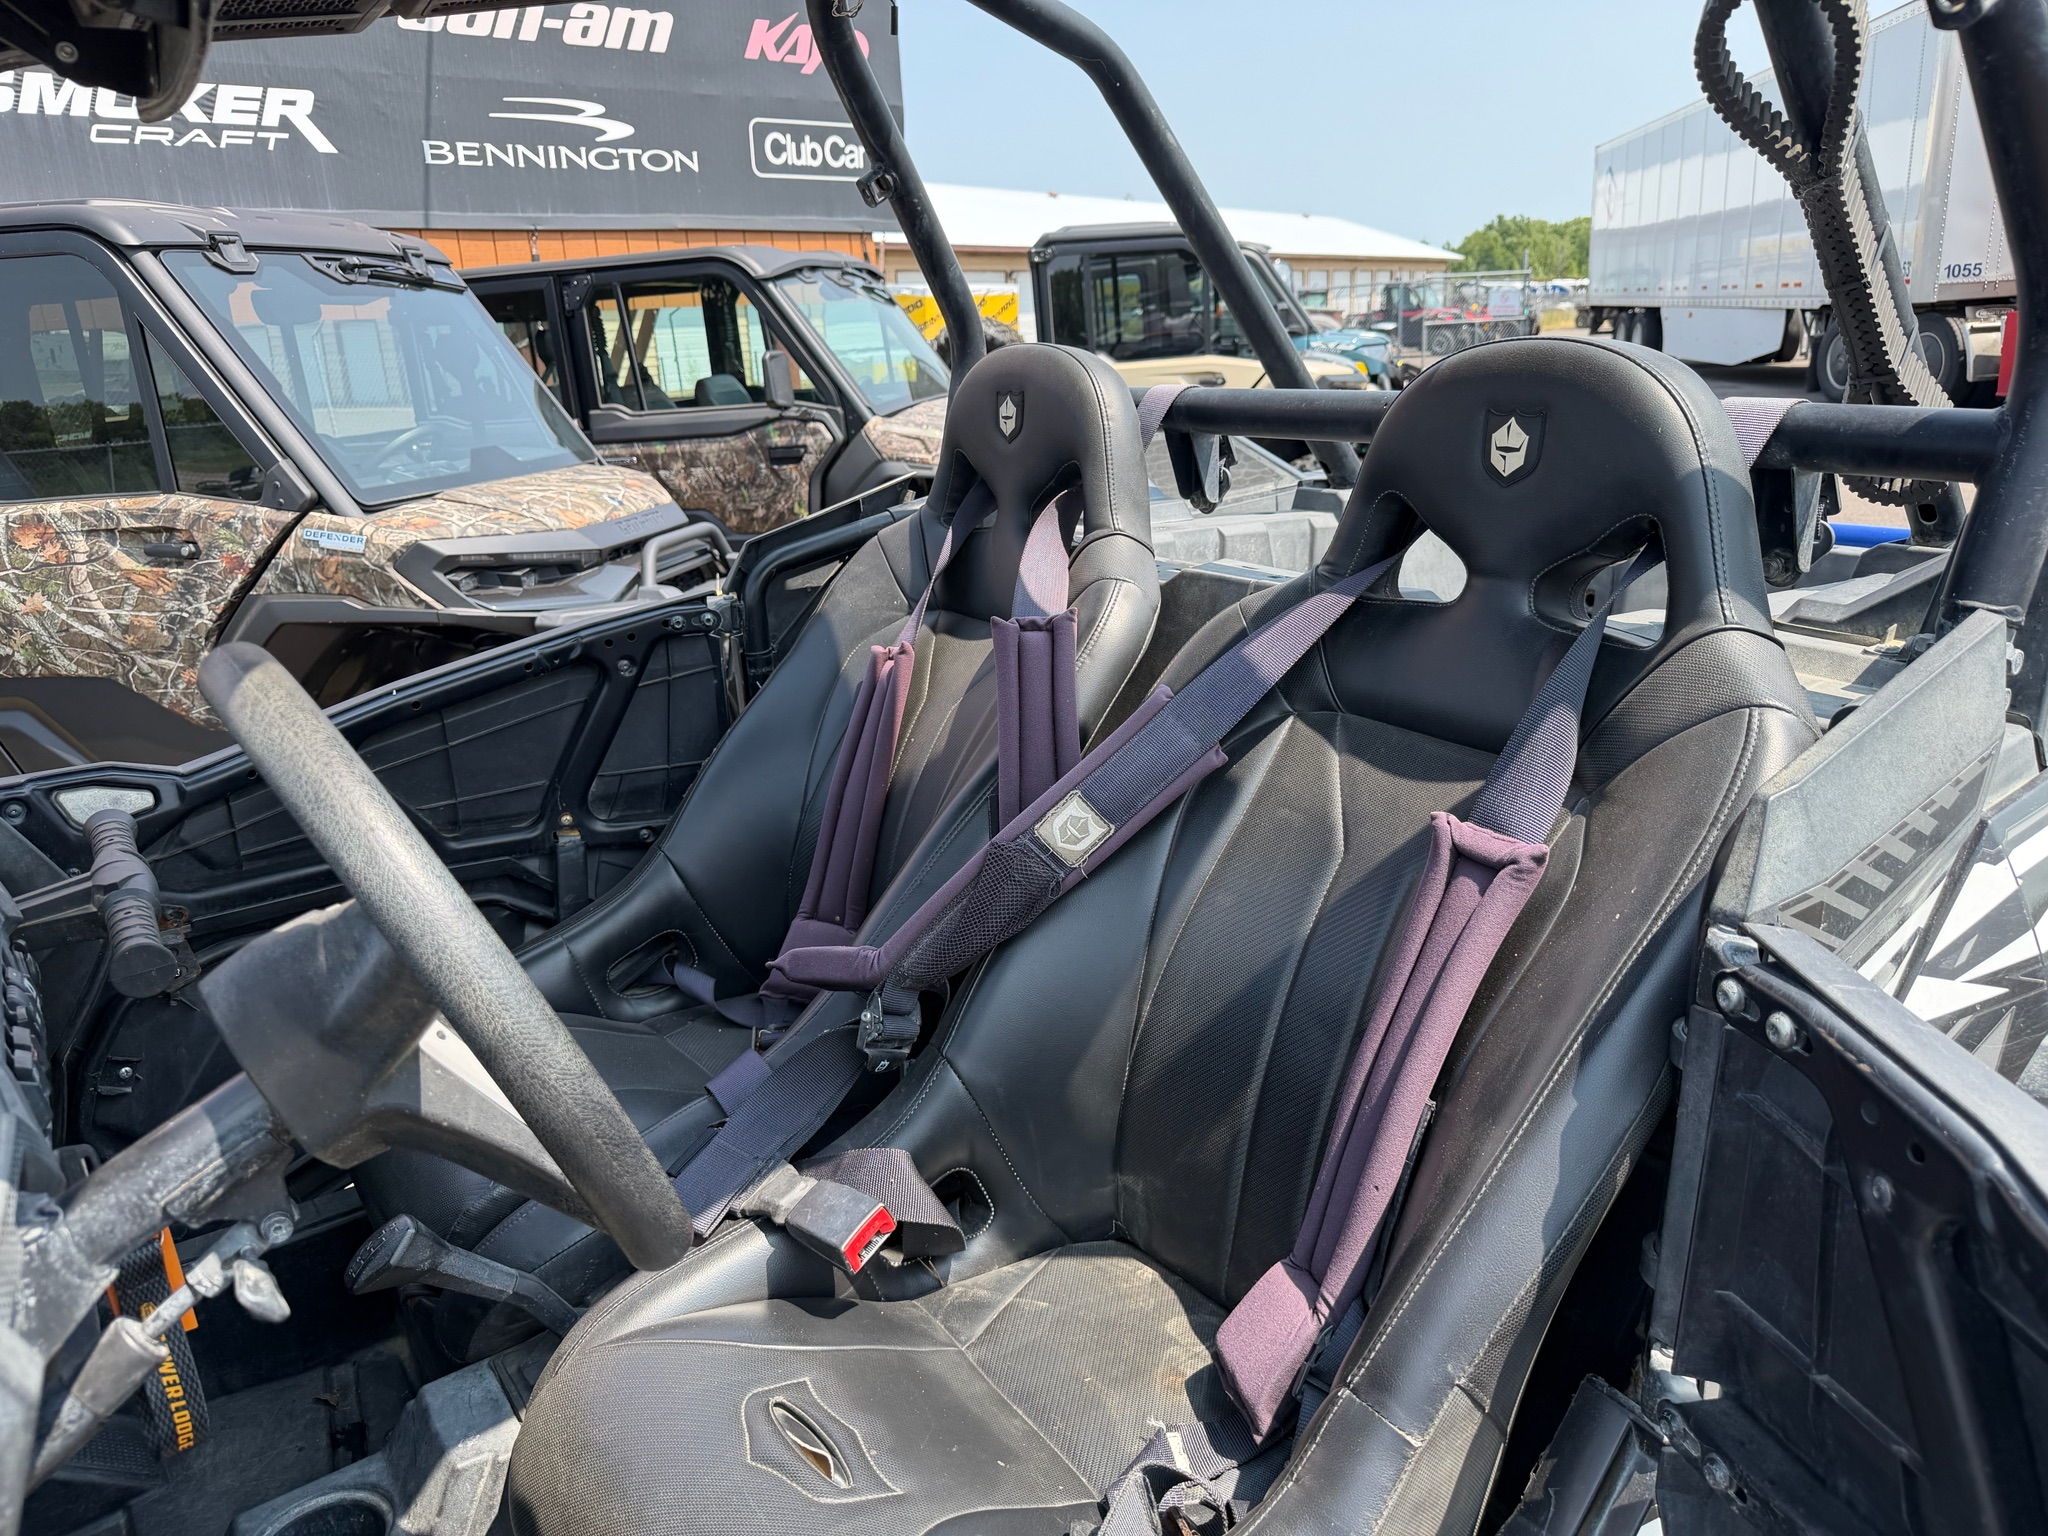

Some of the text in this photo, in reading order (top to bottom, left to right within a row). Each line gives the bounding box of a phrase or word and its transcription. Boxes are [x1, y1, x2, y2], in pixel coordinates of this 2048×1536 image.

[90, 123, 290, 151] CRAFT
[422, 139, 698, 173] BENNINGTON
[1944, 262, 1983, 279] 1055
[305, 530, 364, 544] DEFENDER
[158, 1334, 194, 1451] WER LODGE
